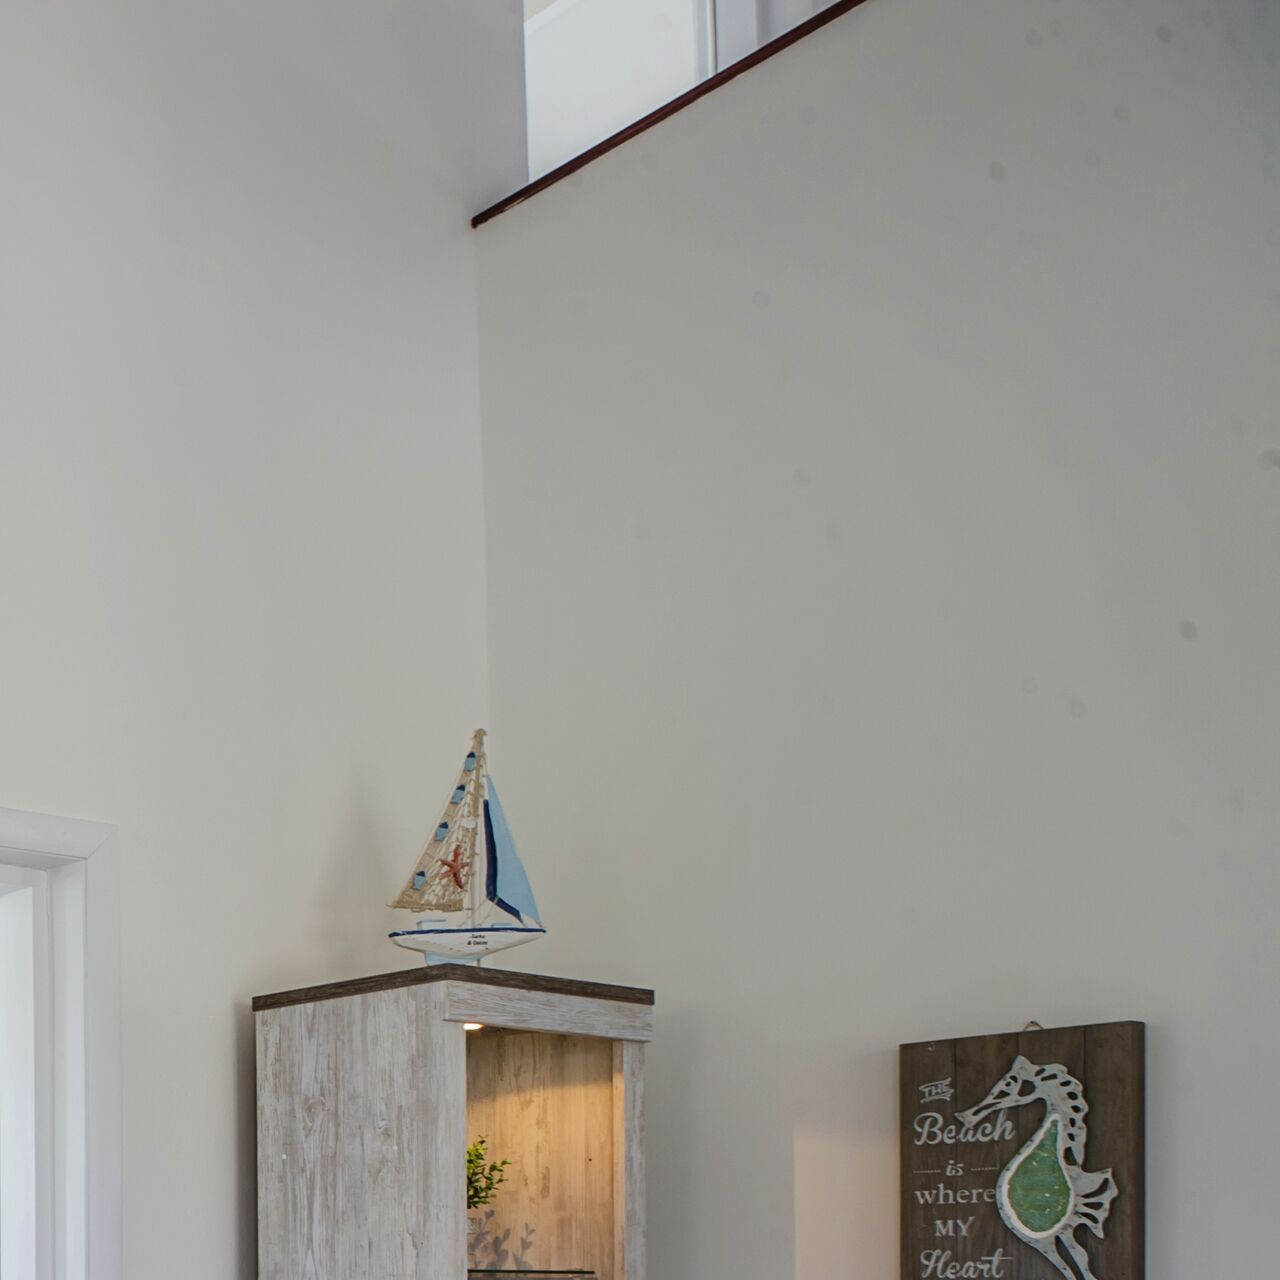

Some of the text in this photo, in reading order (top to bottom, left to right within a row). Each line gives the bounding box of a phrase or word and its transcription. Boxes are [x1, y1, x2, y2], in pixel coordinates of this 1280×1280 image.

[920, 1078, 954, 1100] THE
[914, 1108, 1016, 1145] Beach
[946, 1160, 964, 1176] is
[914, 1184, 995, 1204] where
[935, 1216, 975, 1236] MY
[920, 1248, 1014, 1278] Heart
